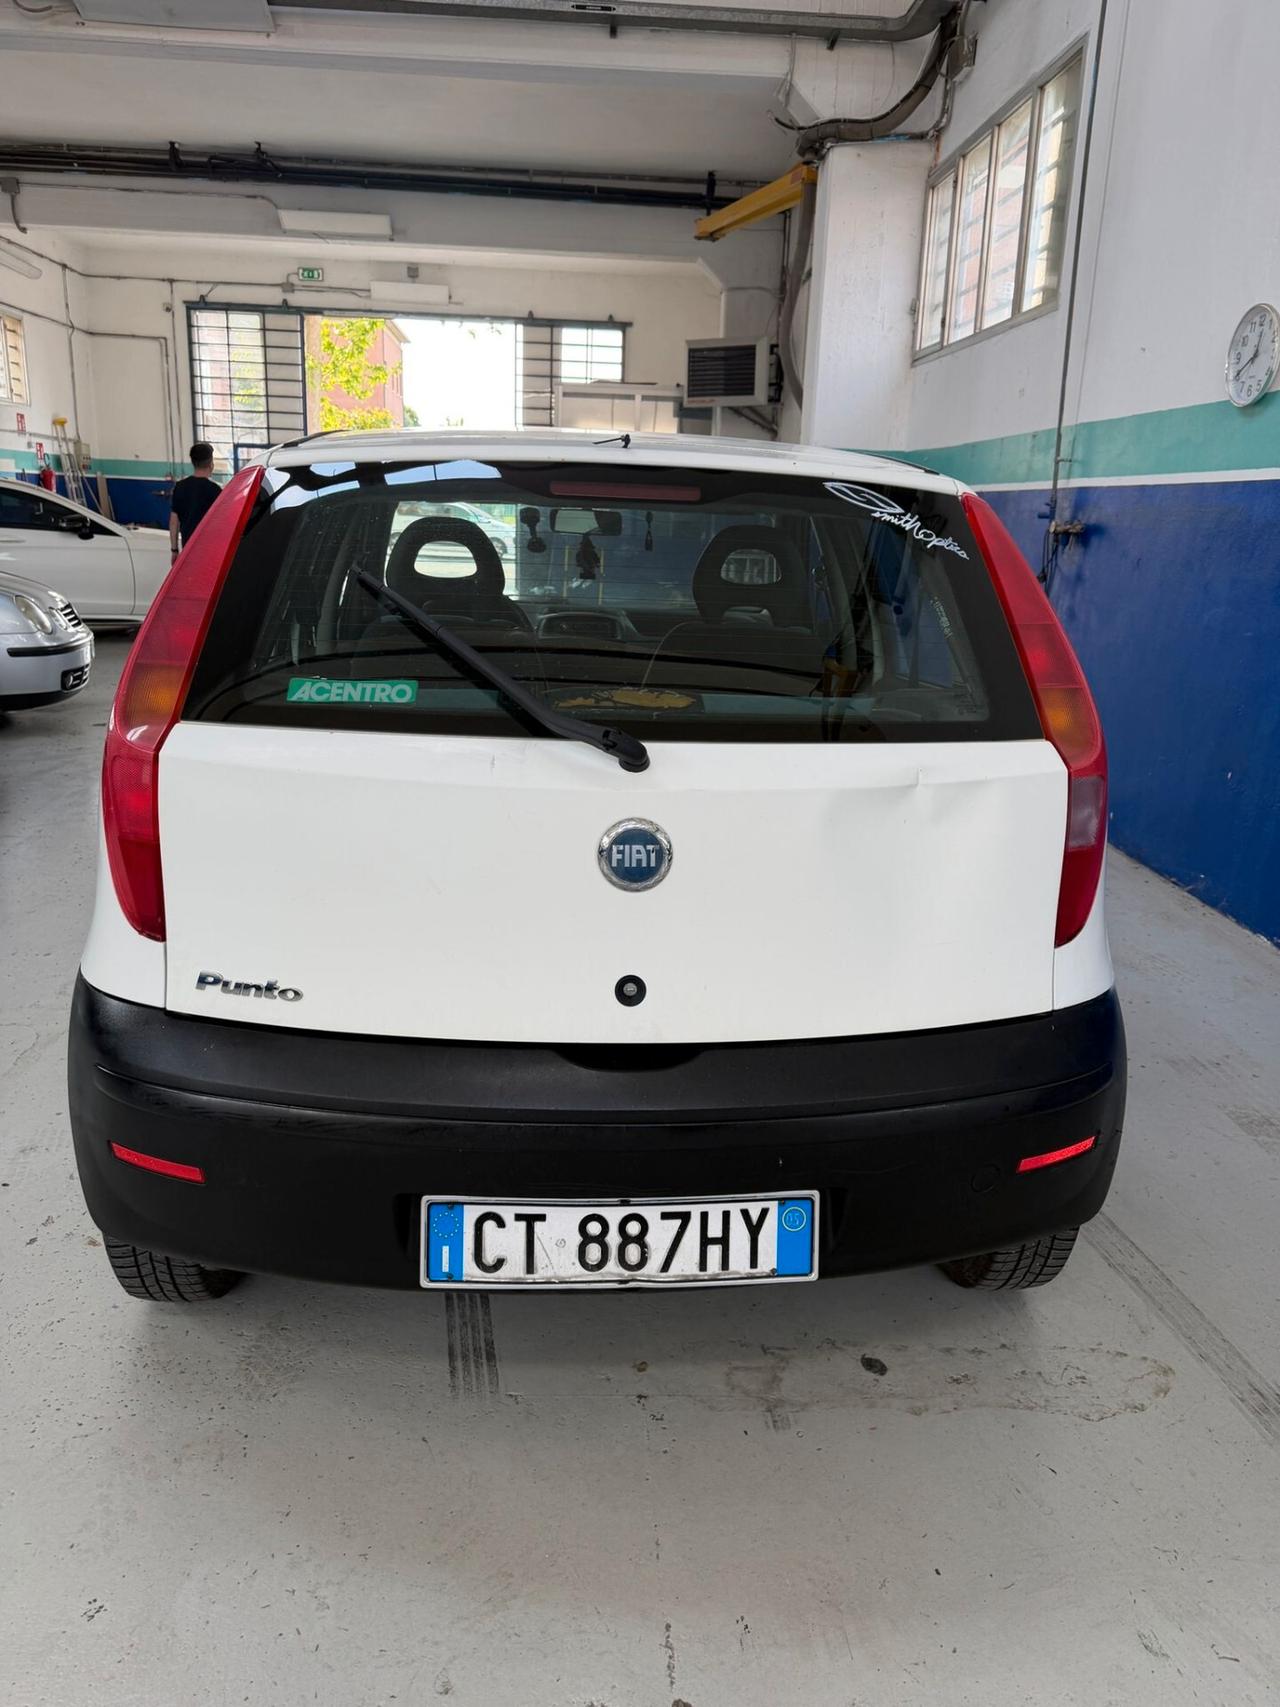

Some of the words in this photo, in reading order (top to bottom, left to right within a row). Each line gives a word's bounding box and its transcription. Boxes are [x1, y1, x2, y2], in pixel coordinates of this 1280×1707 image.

[291, 681, 413, 703] ACENTRO
[611, 844, 660, 868] FIAT
[195, 970, 304, 1002] Punto
[474, 1211, 547, 1275] CT
